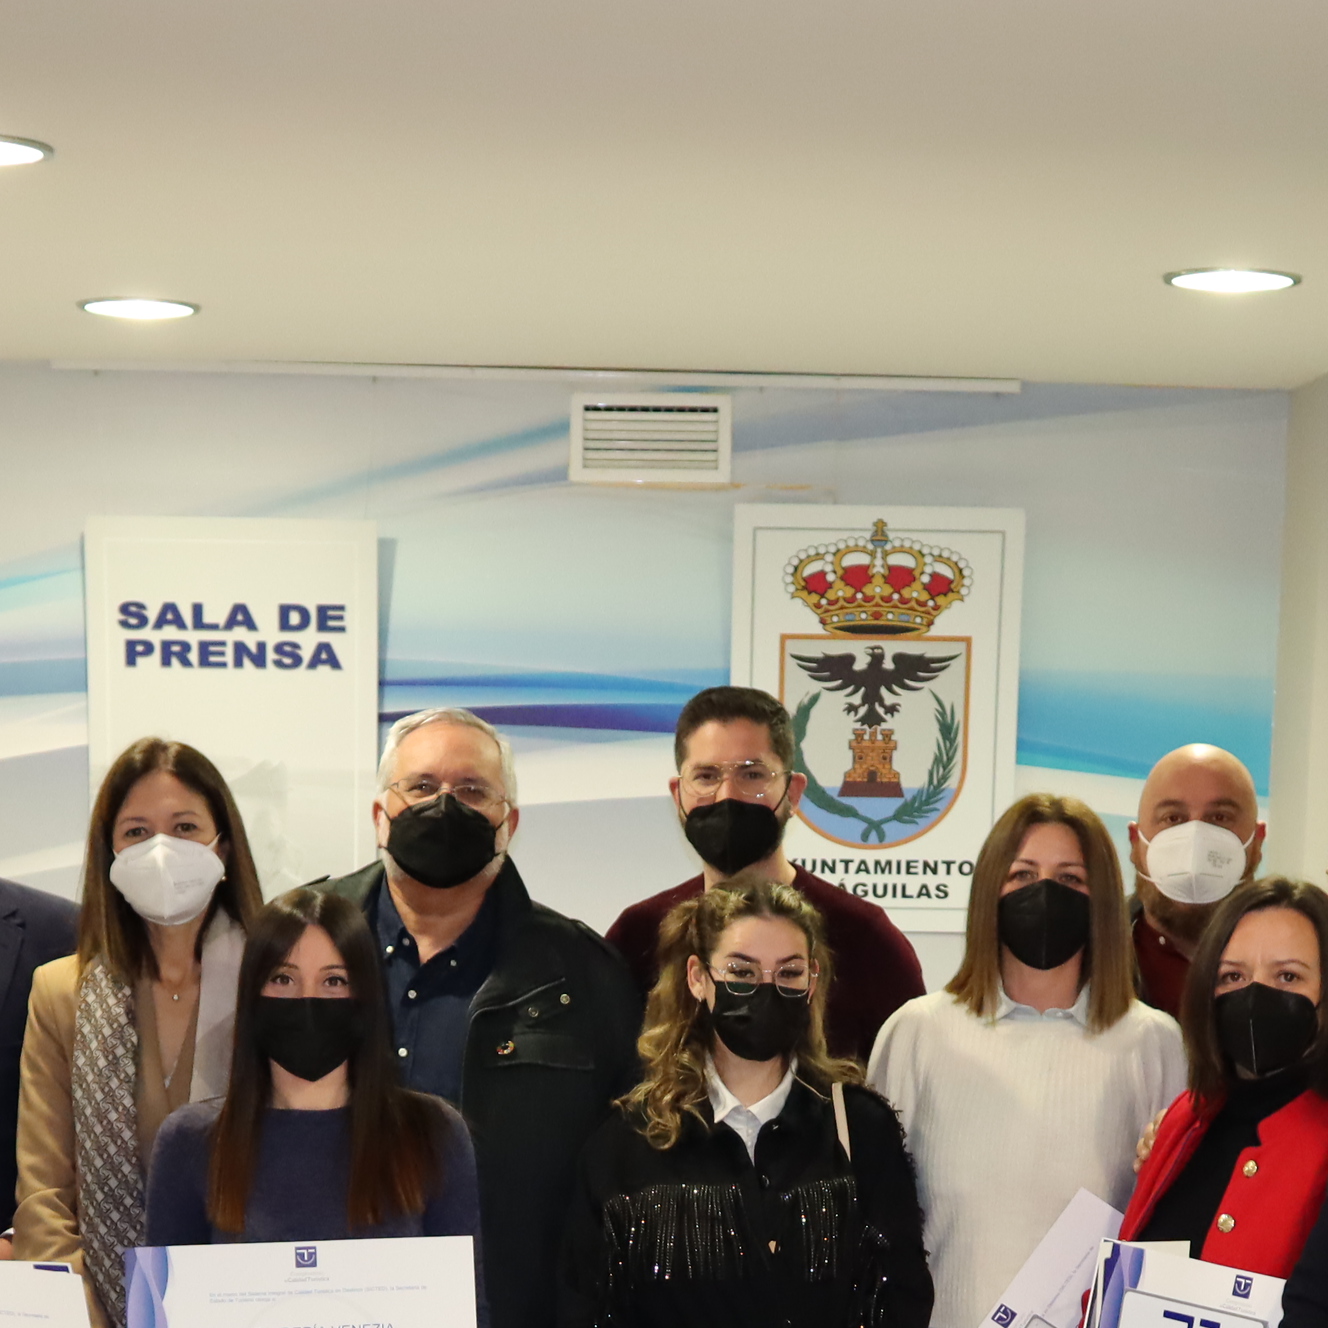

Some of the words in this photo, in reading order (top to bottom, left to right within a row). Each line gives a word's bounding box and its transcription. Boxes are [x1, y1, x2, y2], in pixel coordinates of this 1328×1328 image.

[117, 601, 260, 632] SALA
[277, 603, 347, 633] DE
[124, 638, 344, 671] PRENSA
